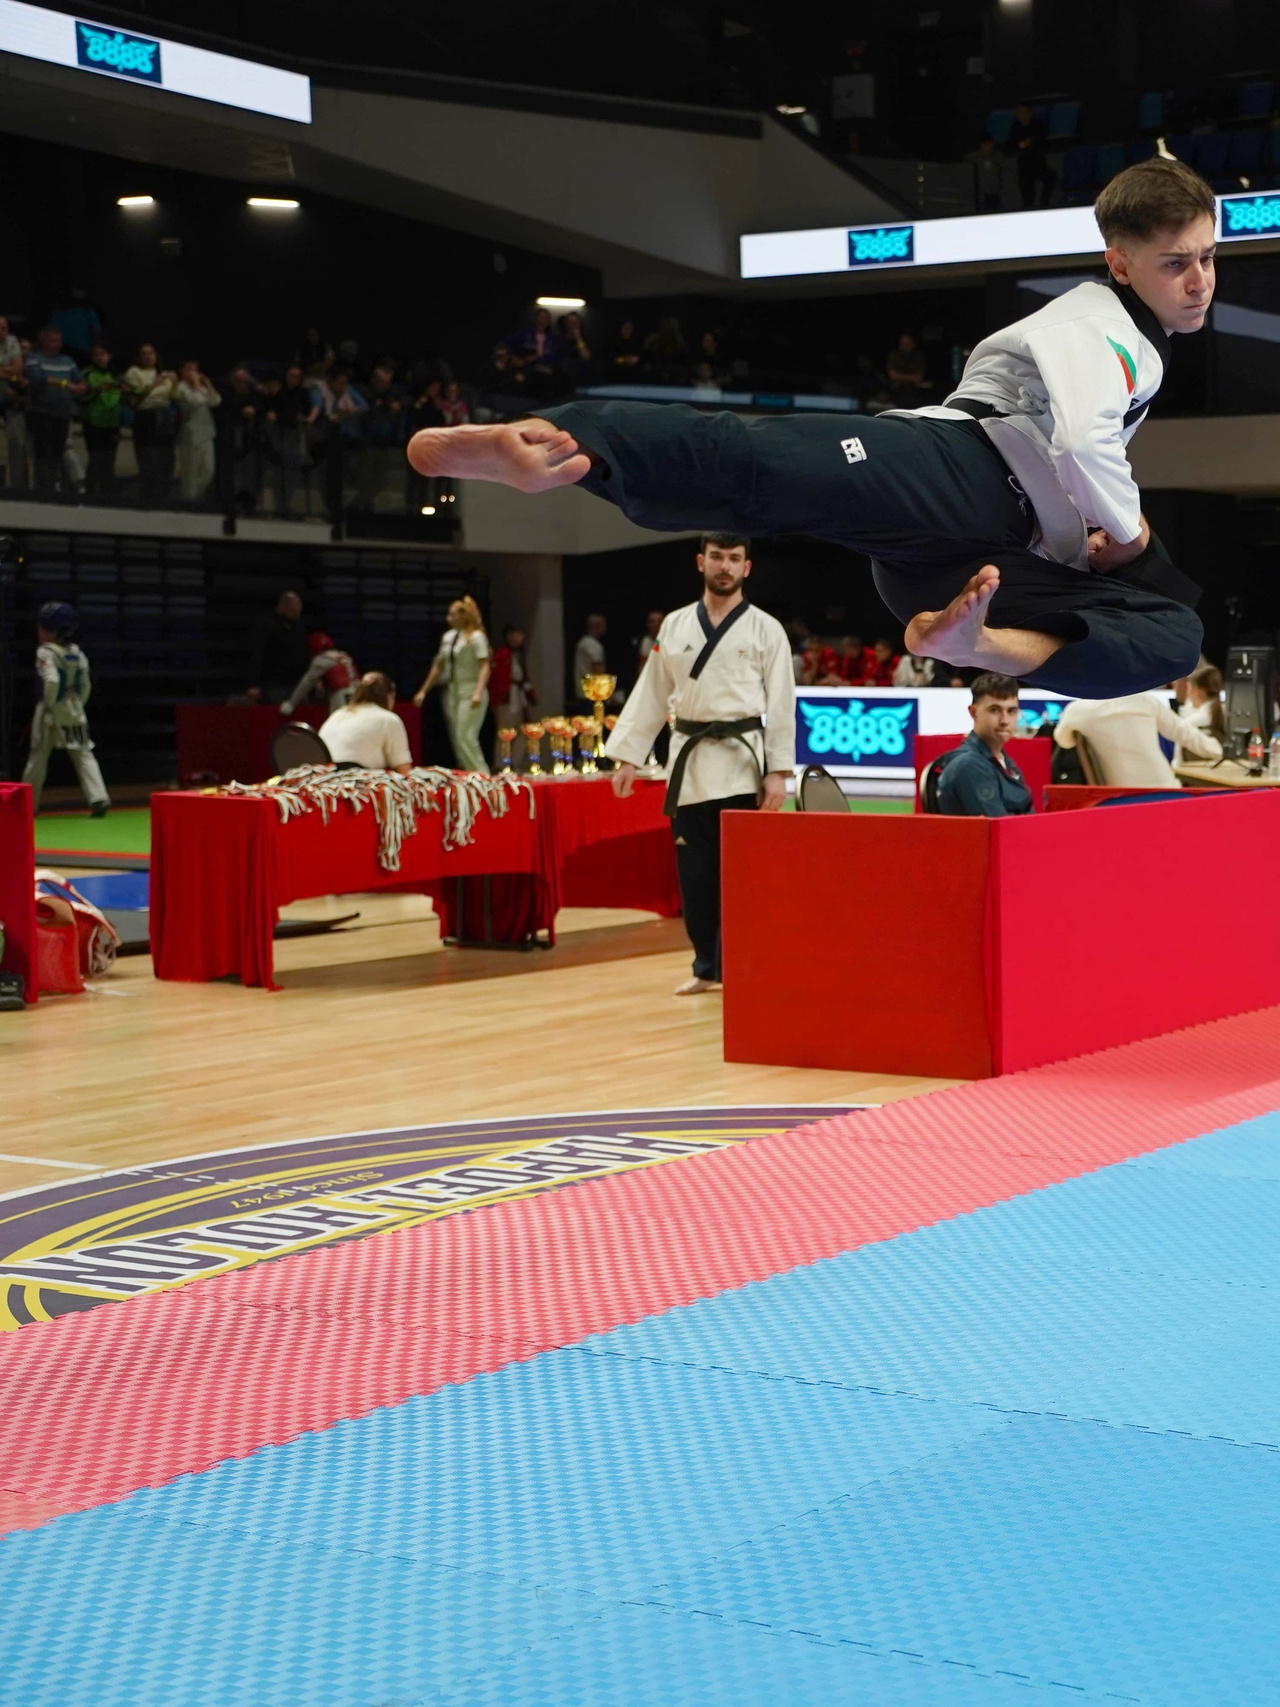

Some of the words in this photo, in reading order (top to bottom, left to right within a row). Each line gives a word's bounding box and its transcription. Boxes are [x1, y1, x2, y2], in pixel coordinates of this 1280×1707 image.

[87, 37, 153, 74] 8888
[854, 236, 908, 260] 8888
[807, 714, 906, 755] 8888
[299, 1171, 384, 1193] Since
[346, 1133, 722, 1207] HAPOEL
[231, 1189, 297, 1209] 1947
[0, 1203, 394, 1293] HOLON
